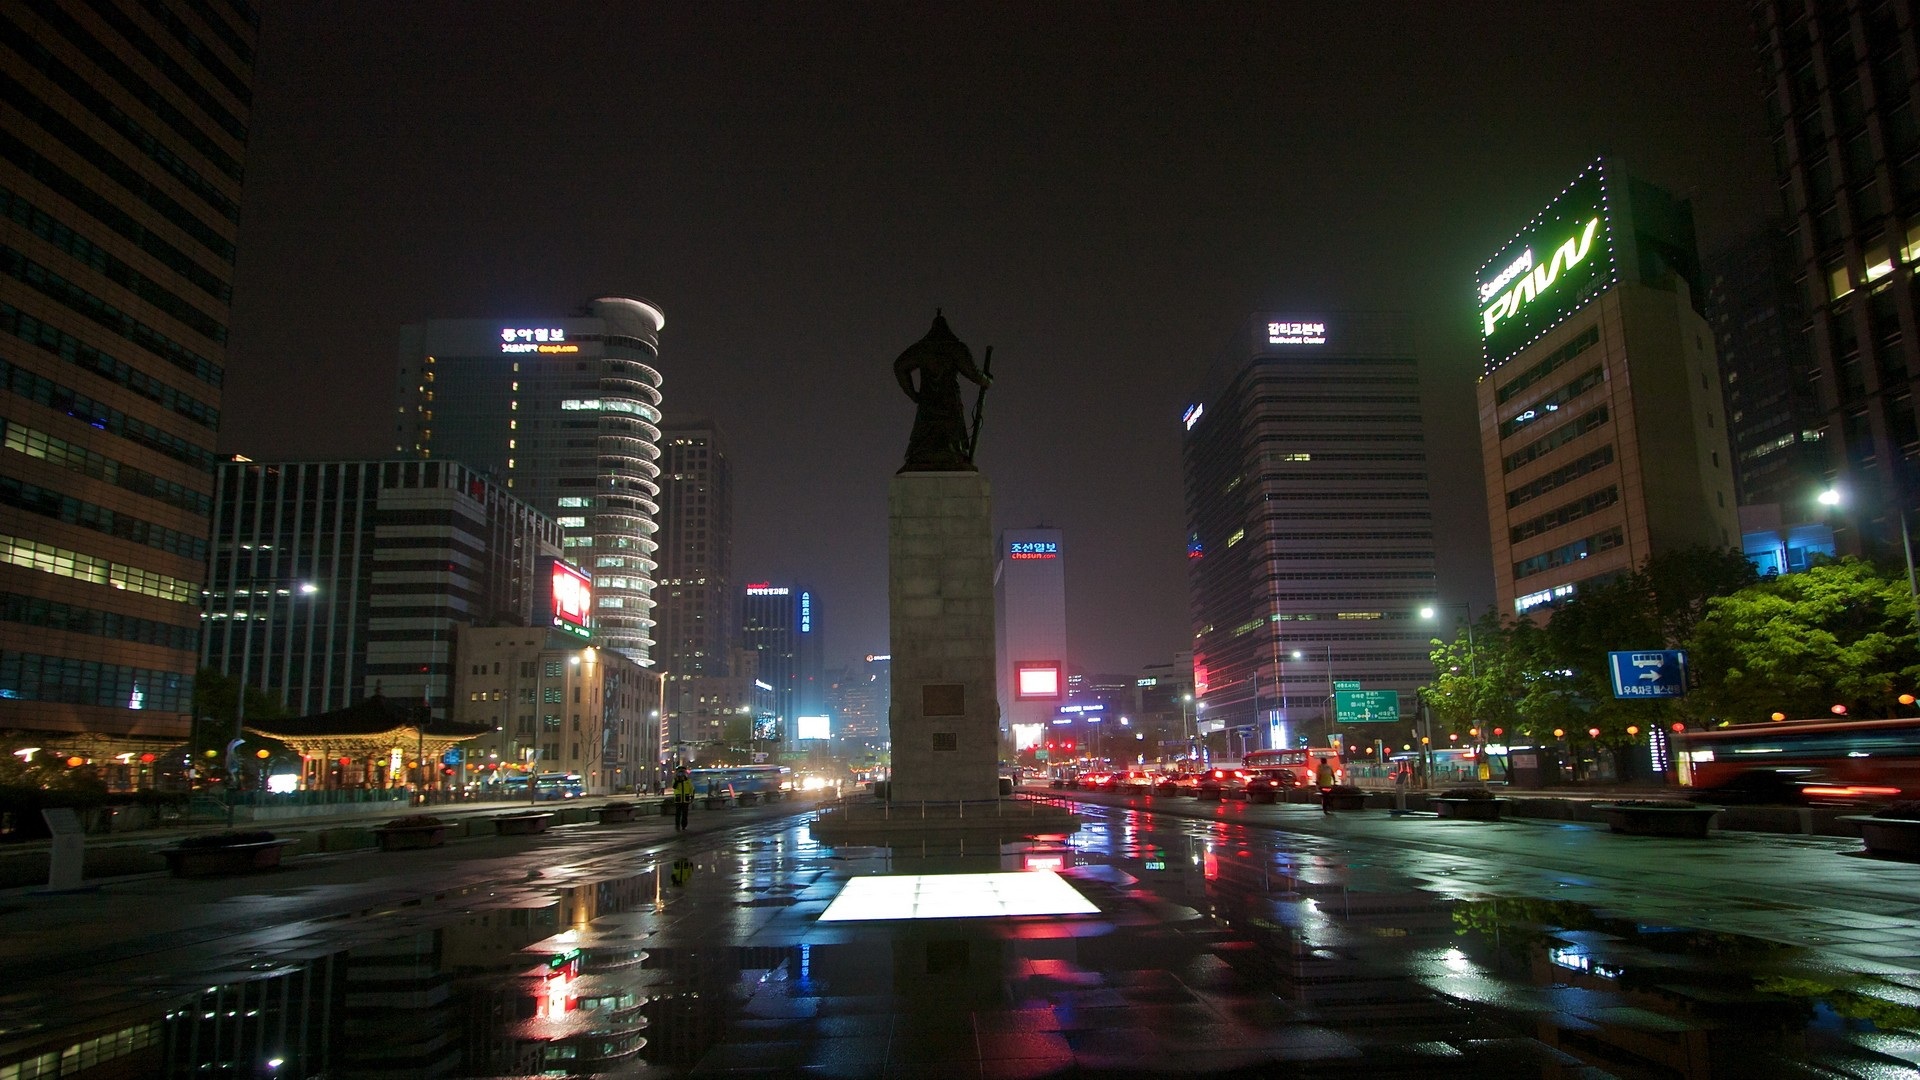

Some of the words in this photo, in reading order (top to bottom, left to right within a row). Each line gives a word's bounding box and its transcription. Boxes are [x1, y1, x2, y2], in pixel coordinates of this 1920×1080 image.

[501, 328, 565, 342] 동아일보
[1268, 322, 1325, 336] 감리교본부
[1011, 542, 1057, 553] 조선일보
